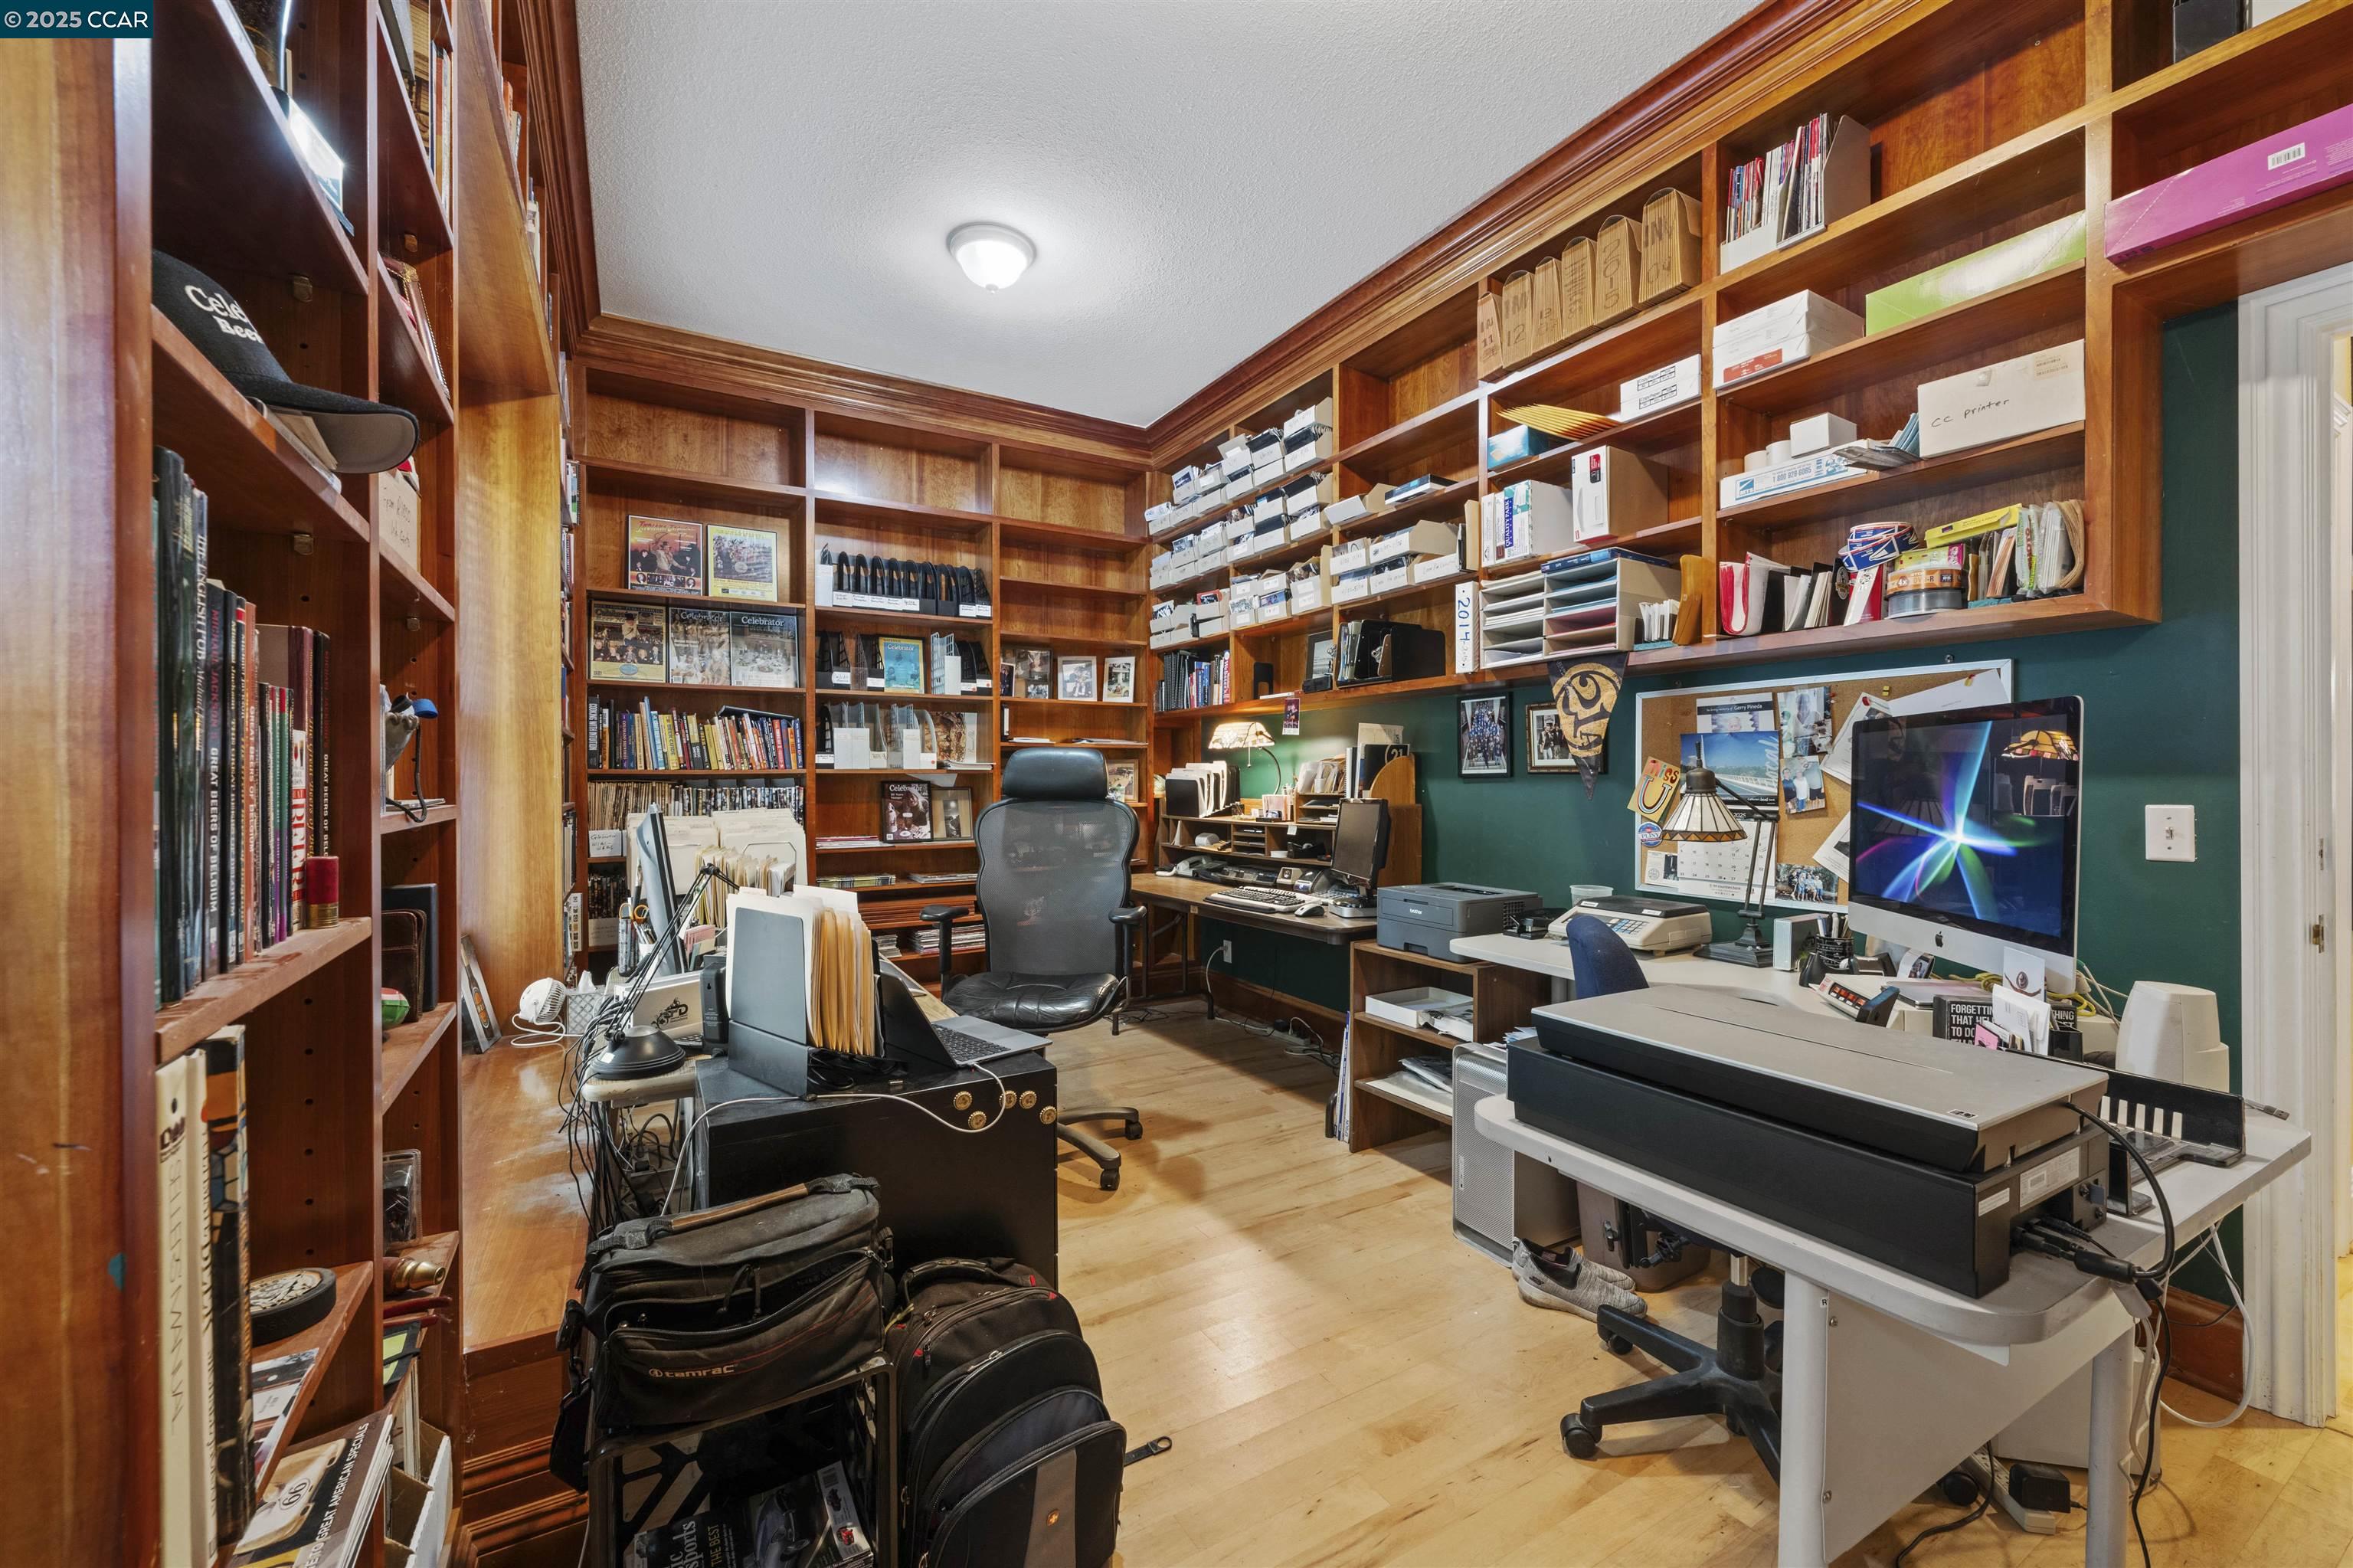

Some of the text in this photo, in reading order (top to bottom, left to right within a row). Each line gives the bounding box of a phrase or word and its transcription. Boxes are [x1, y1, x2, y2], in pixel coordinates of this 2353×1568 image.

[1931, 397, 2010, 428] CC printer
[1913, 575, 1935, 584] DV-R
[197, 562, 207, 626] ENGLISH
[741, 616, 785, 627] Celebrator
[196, 628, 207, 661] PUB
[210, 610, 219, 664] MICHAEL
[588, 703, 597, 721] COOKING
[588, 721, 597, 732] WITH
[209, 747, 218, 787] GREAT
[249, 786, 255, 800] OF
[1637, 775, 1673, 814] U
[209, 790, 218, 831] BEERS
[322, 819, 329, 833] OF
[209, 835, 218, 851] OF
[208, 856, 218, 913] BELGIUM
[1950, 1003, 1993, 1015] FORGETTIN
[1951, 1014, 1974, 1026] THAT
[1951, 1026, 1962, 1037] TO
[664, 1364, 735, 1378] tamrac
[348, 1422, 370, 1463] SPECIALS
[282, 1481, 308, 1507] 66
[329, 1462, 355, 1509] AMERICAN
[315, 1508, 338, 1541] GREAT
[309, 1542, 326, 1559] TO
[707, 1524, 723, 1568] THE BEST
